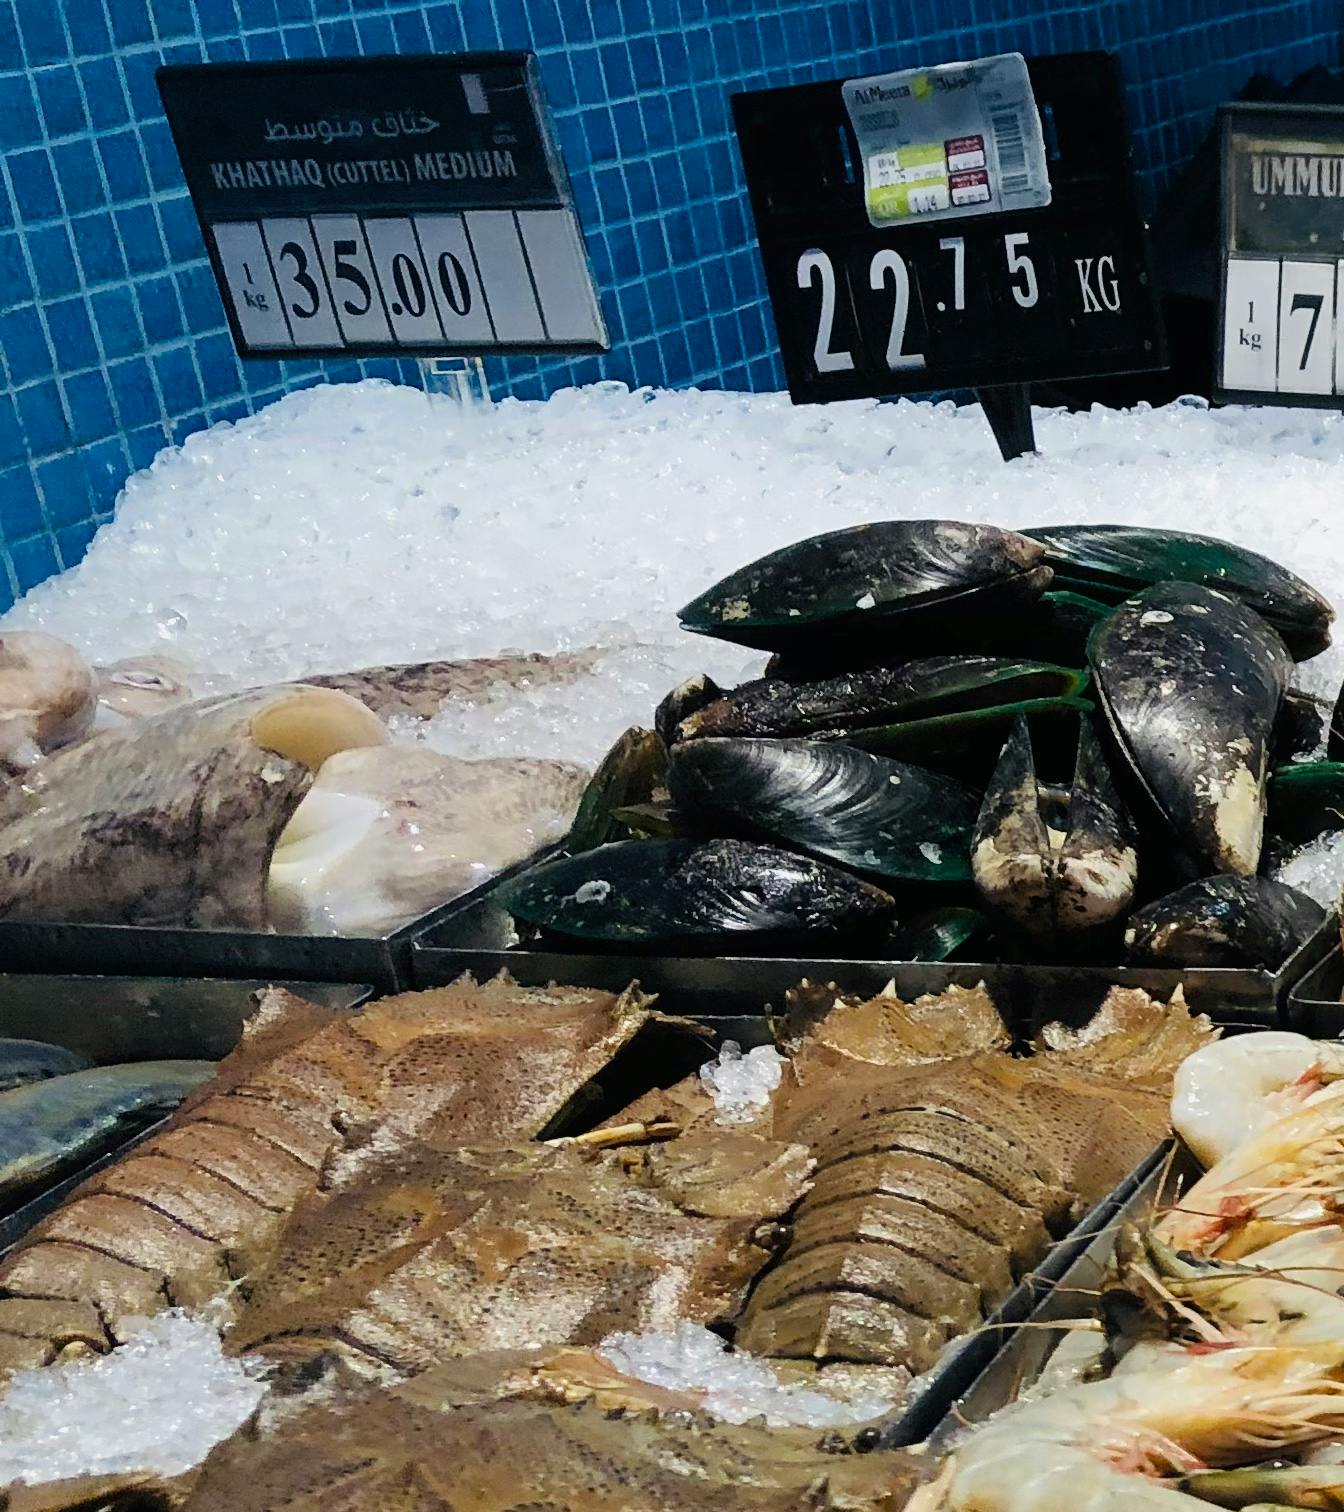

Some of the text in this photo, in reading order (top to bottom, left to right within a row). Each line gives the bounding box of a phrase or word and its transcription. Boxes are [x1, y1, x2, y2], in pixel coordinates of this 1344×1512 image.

[264, 114, 364, 144] متوسط
[211, 150, 518, 189] KHATHAQ (CUTTEL) MEDIUM
[279, 239, 472, 320] 35.00
[1075, 255, 1122, 313] KG
[243, 289, 270, 312] kg
[1238, 328, 1263, 351] kg
